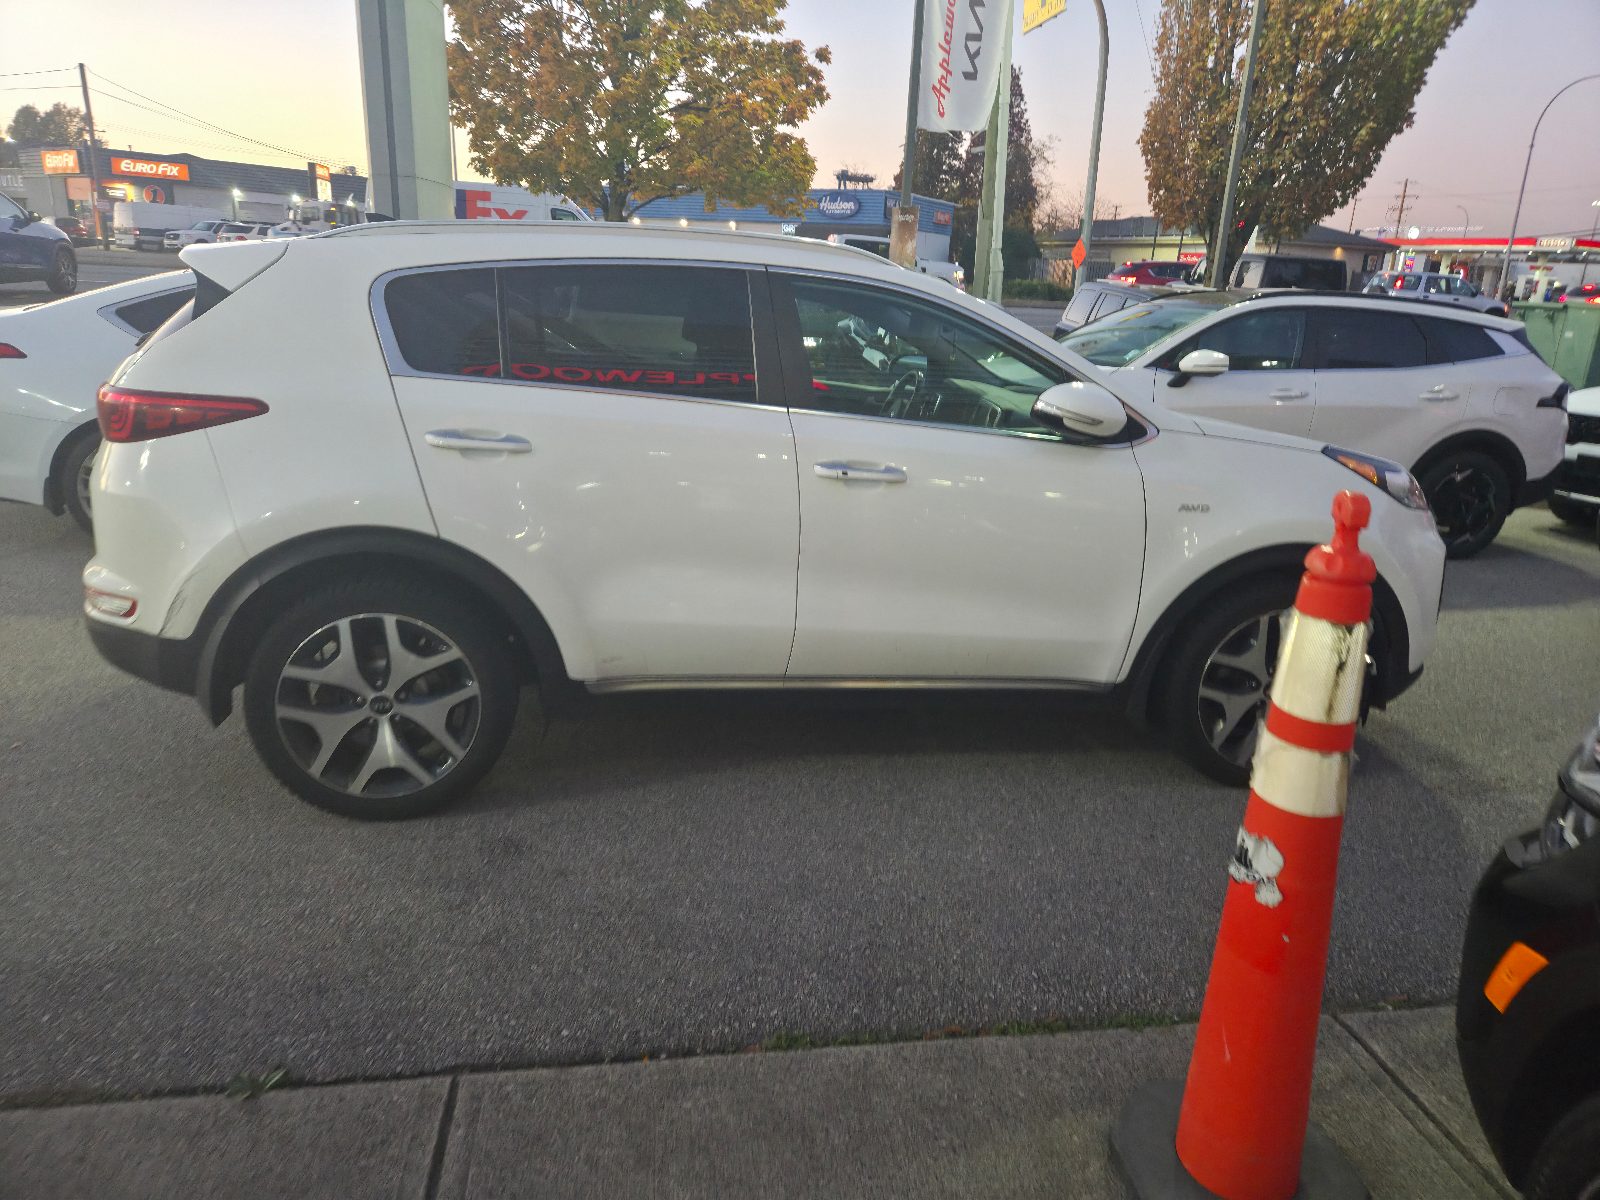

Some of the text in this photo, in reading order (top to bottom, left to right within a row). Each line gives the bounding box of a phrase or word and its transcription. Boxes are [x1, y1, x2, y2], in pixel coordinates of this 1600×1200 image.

[120, 159, 157, 174] EURO
[820, 195, 855, 211] Hudson
[1178, 503, 1211, 513] AWD
